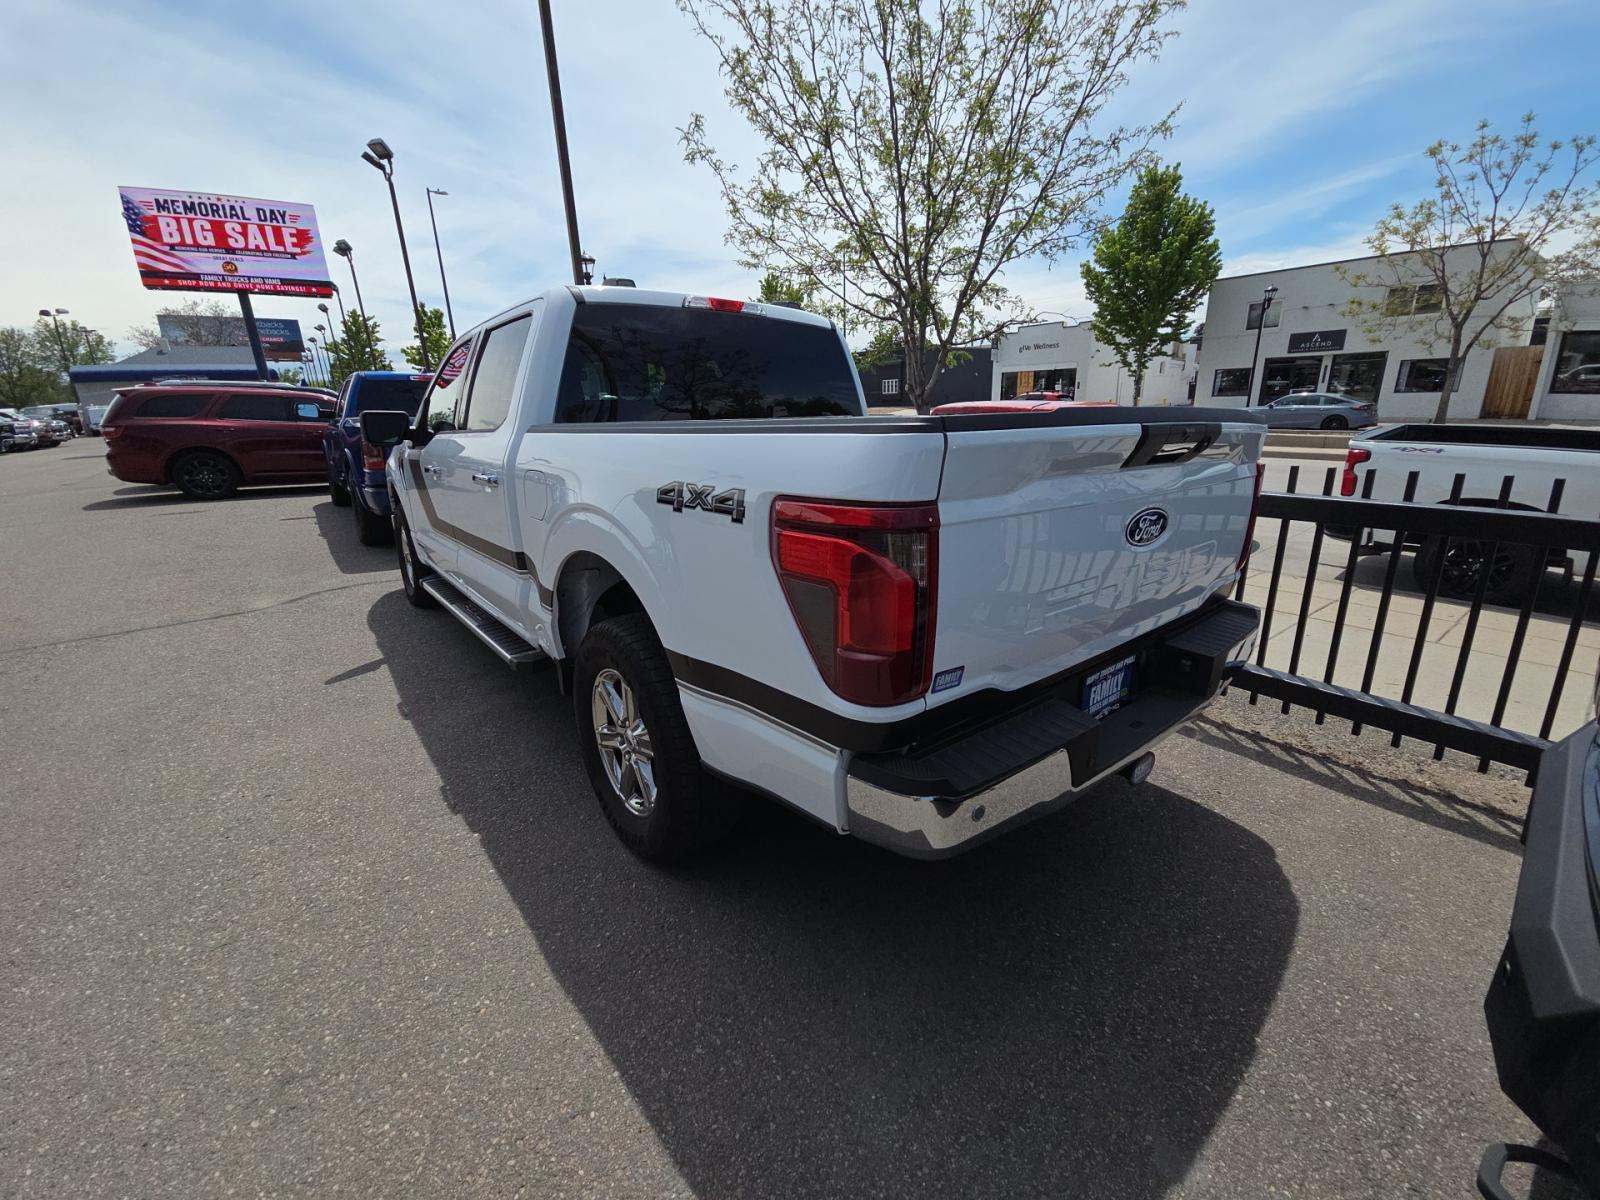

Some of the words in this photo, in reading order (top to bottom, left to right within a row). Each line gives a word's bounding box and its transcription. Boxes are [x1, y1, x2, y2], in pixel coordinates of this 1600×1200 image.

[154, 198, 252, 221] MEMORIAL
[255, 207, 289, 225] DAY
[157, 216, 216, 247] BIG
[226, 222, 302, 253] SALE
[200, 274, 223, 282] FAMILY
[1033, 342, 1060, 350] Wellness
[1300, 340, 1332, 348] ASCEND
[1134, 515, 1163, 541] Ford
[1090, 672, 1124, 706] FAMILY
